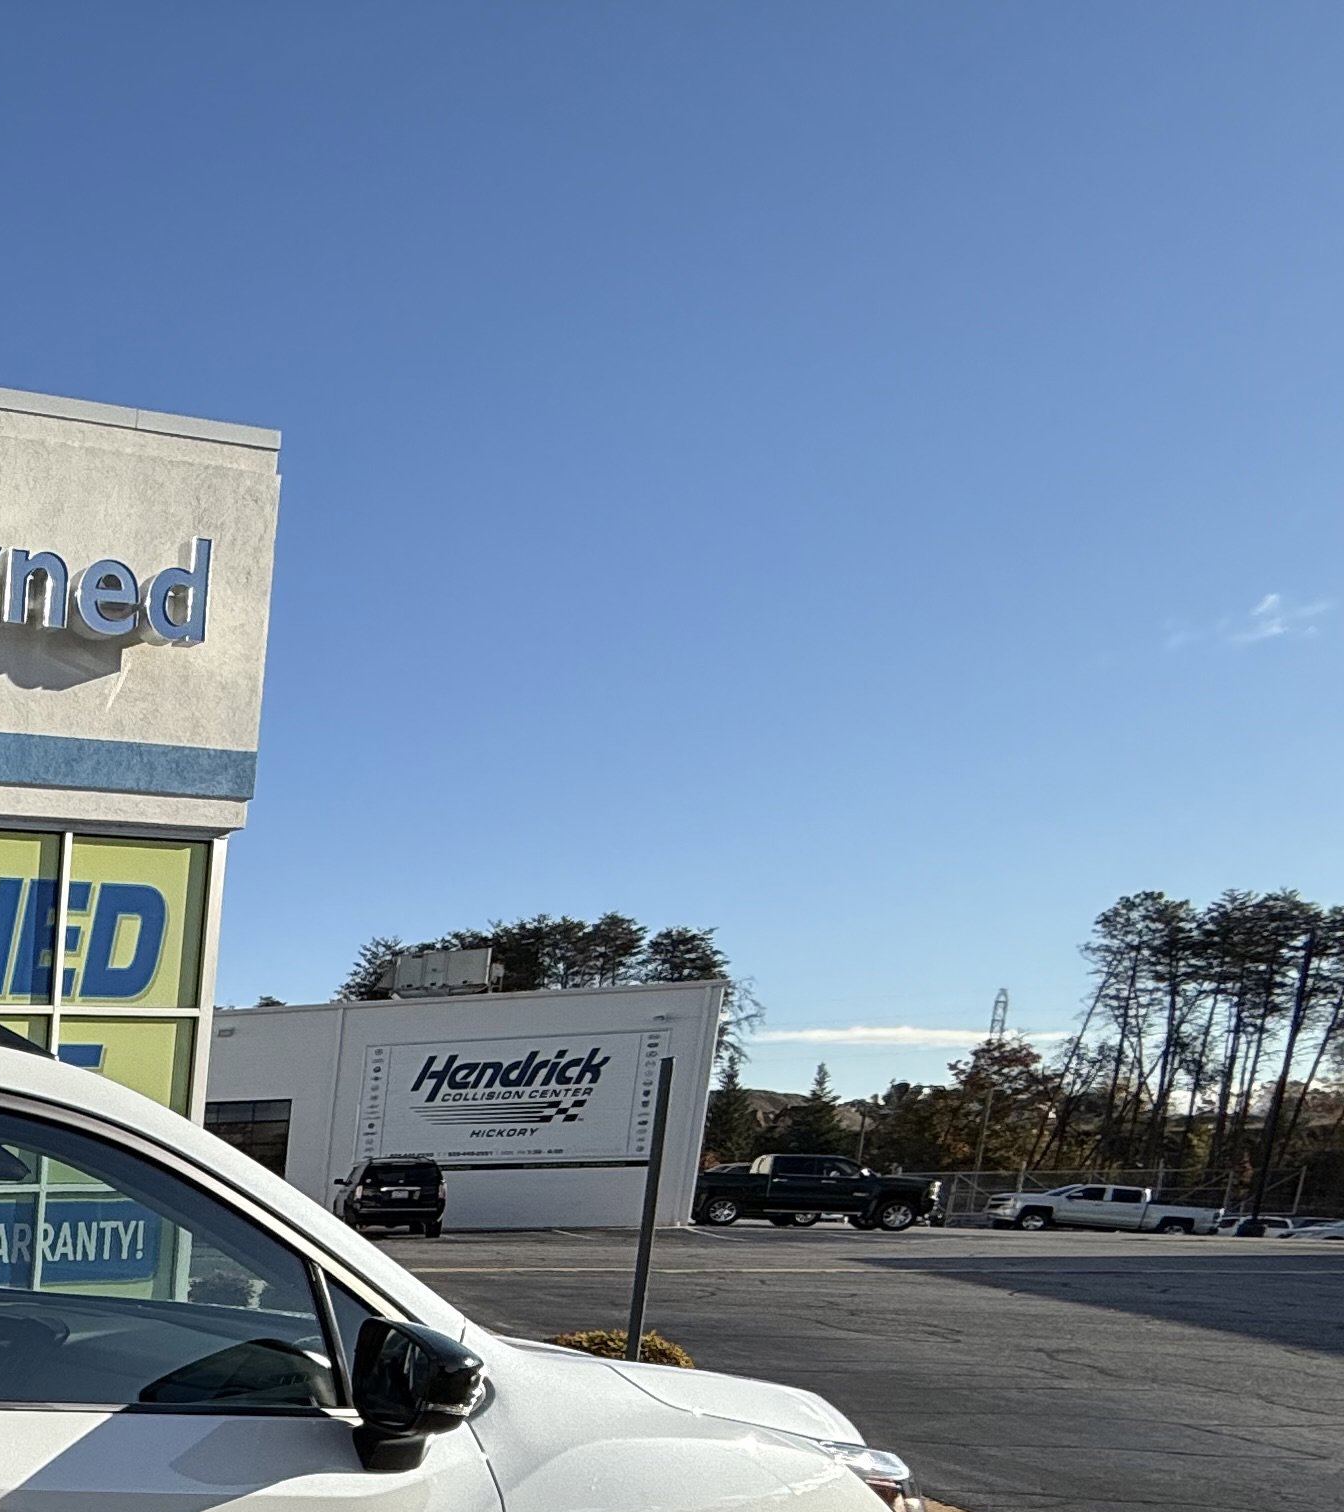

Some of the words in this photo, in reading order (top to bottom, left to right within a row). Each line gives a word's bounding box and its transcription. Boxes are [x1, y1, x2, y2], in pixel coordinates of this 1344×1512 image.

[410, 1047, 612, 1103] Hendrick
[441, 1089, 525, 1103] COLLISION
[528, 1087, 594, 1099] CENTER
[469, 1127, 540, 1139] HICKORY
